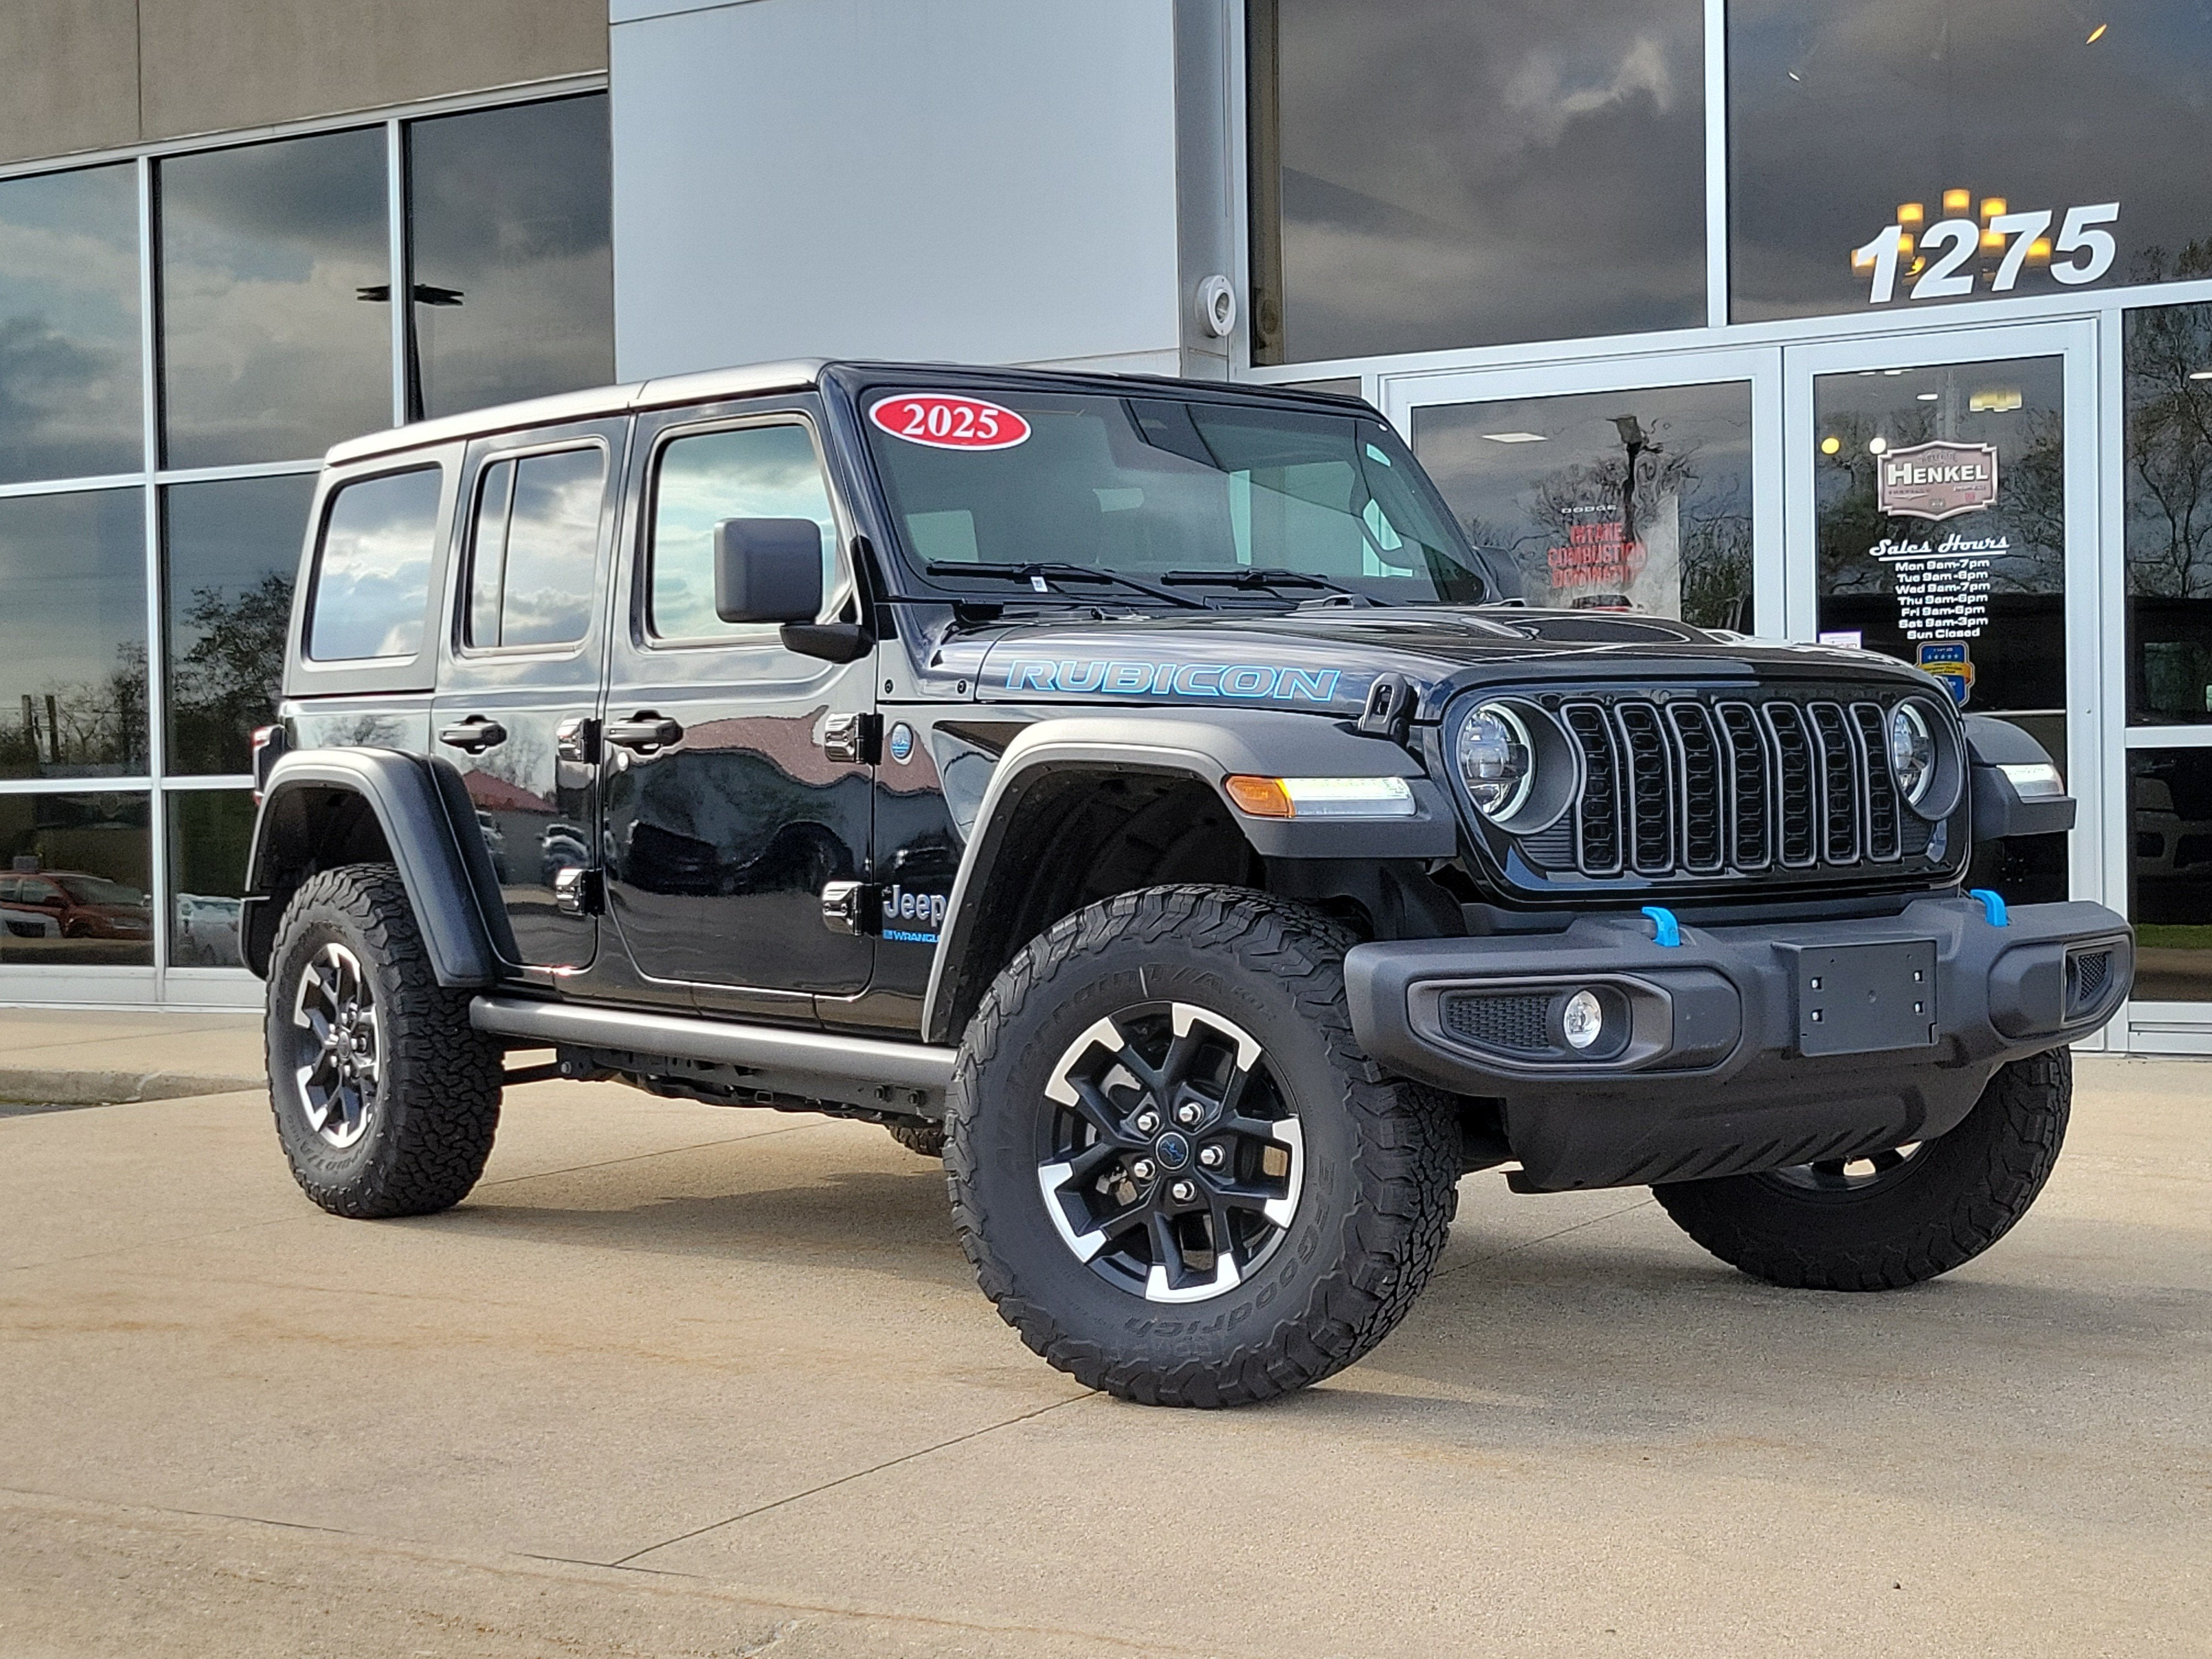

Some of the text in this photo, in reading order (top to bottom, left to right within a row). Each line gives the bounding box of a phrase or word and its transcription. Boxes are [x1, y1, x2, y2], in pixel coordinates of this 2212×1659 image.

[1857, 202, 2120, 304] 1275
[901, 403, 998, 439] 2025
[1887, 463, 1989, 486] HENKEL
[1561, 505, 1617, 514] DODGE
[1869, 533, 2010, 556] Sales Hours
[1895, 558, 1990, 571] Mon 9am-7pm
[1897, 573, 1920, 583] Tue
[1895, 582, 1990, 594] Wed 9am-7pm
[1897, 596, 1923, 605] Thu
[1901, 607, 1920, 616] Fri
[1898, 617, 1988, 628] Sat 9am-3pm
[1907, 628, 1980, 639] Sun Closed
[1006, 659, 1342, 702] RUBICON
[883, 884, 947, 927] Jeep
[894, 930, 940, 943] WRANGL
